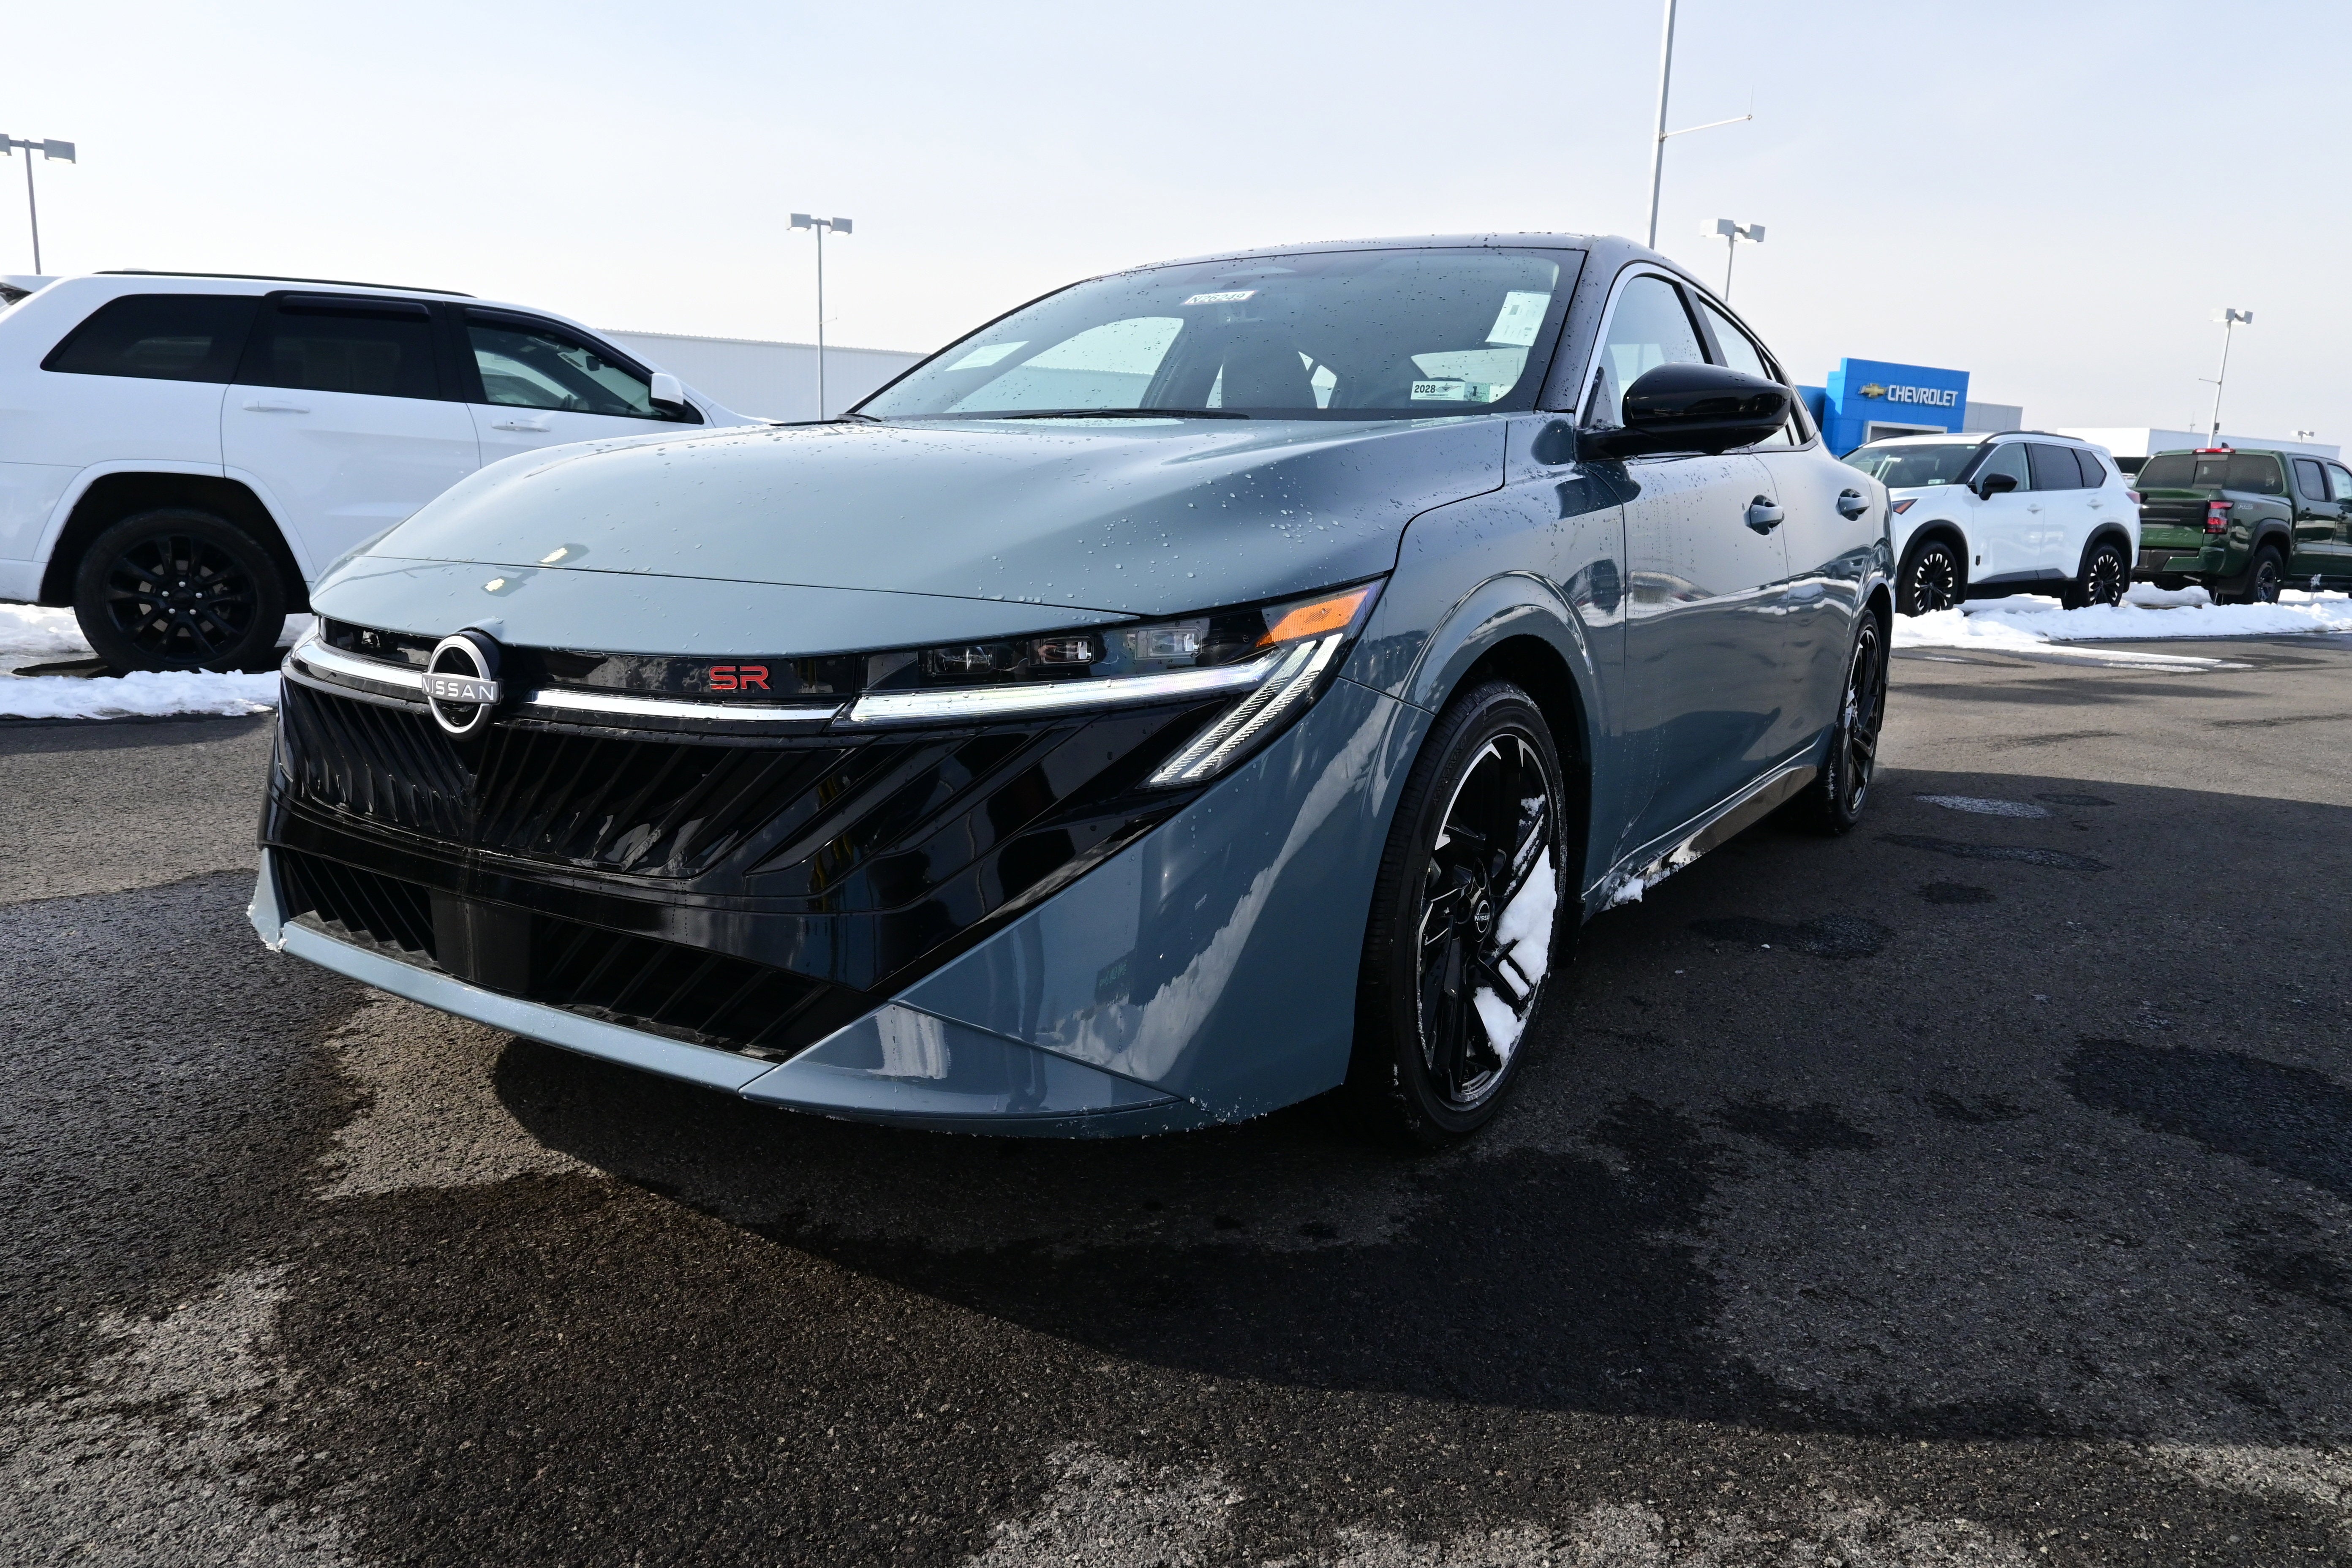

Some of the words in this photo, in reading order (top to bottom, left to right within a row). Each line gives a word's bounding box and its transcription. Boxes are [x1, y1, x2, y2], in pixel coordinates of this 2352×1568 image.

[1189, 293, 1246, 302] N26249
[1414, 384, 1436, 393] 2028
[1888, 385, 1958, 406] CHEVROLET
[709, 666, 770, 689] SR
[422, 677, 494, 700] NISSAN
